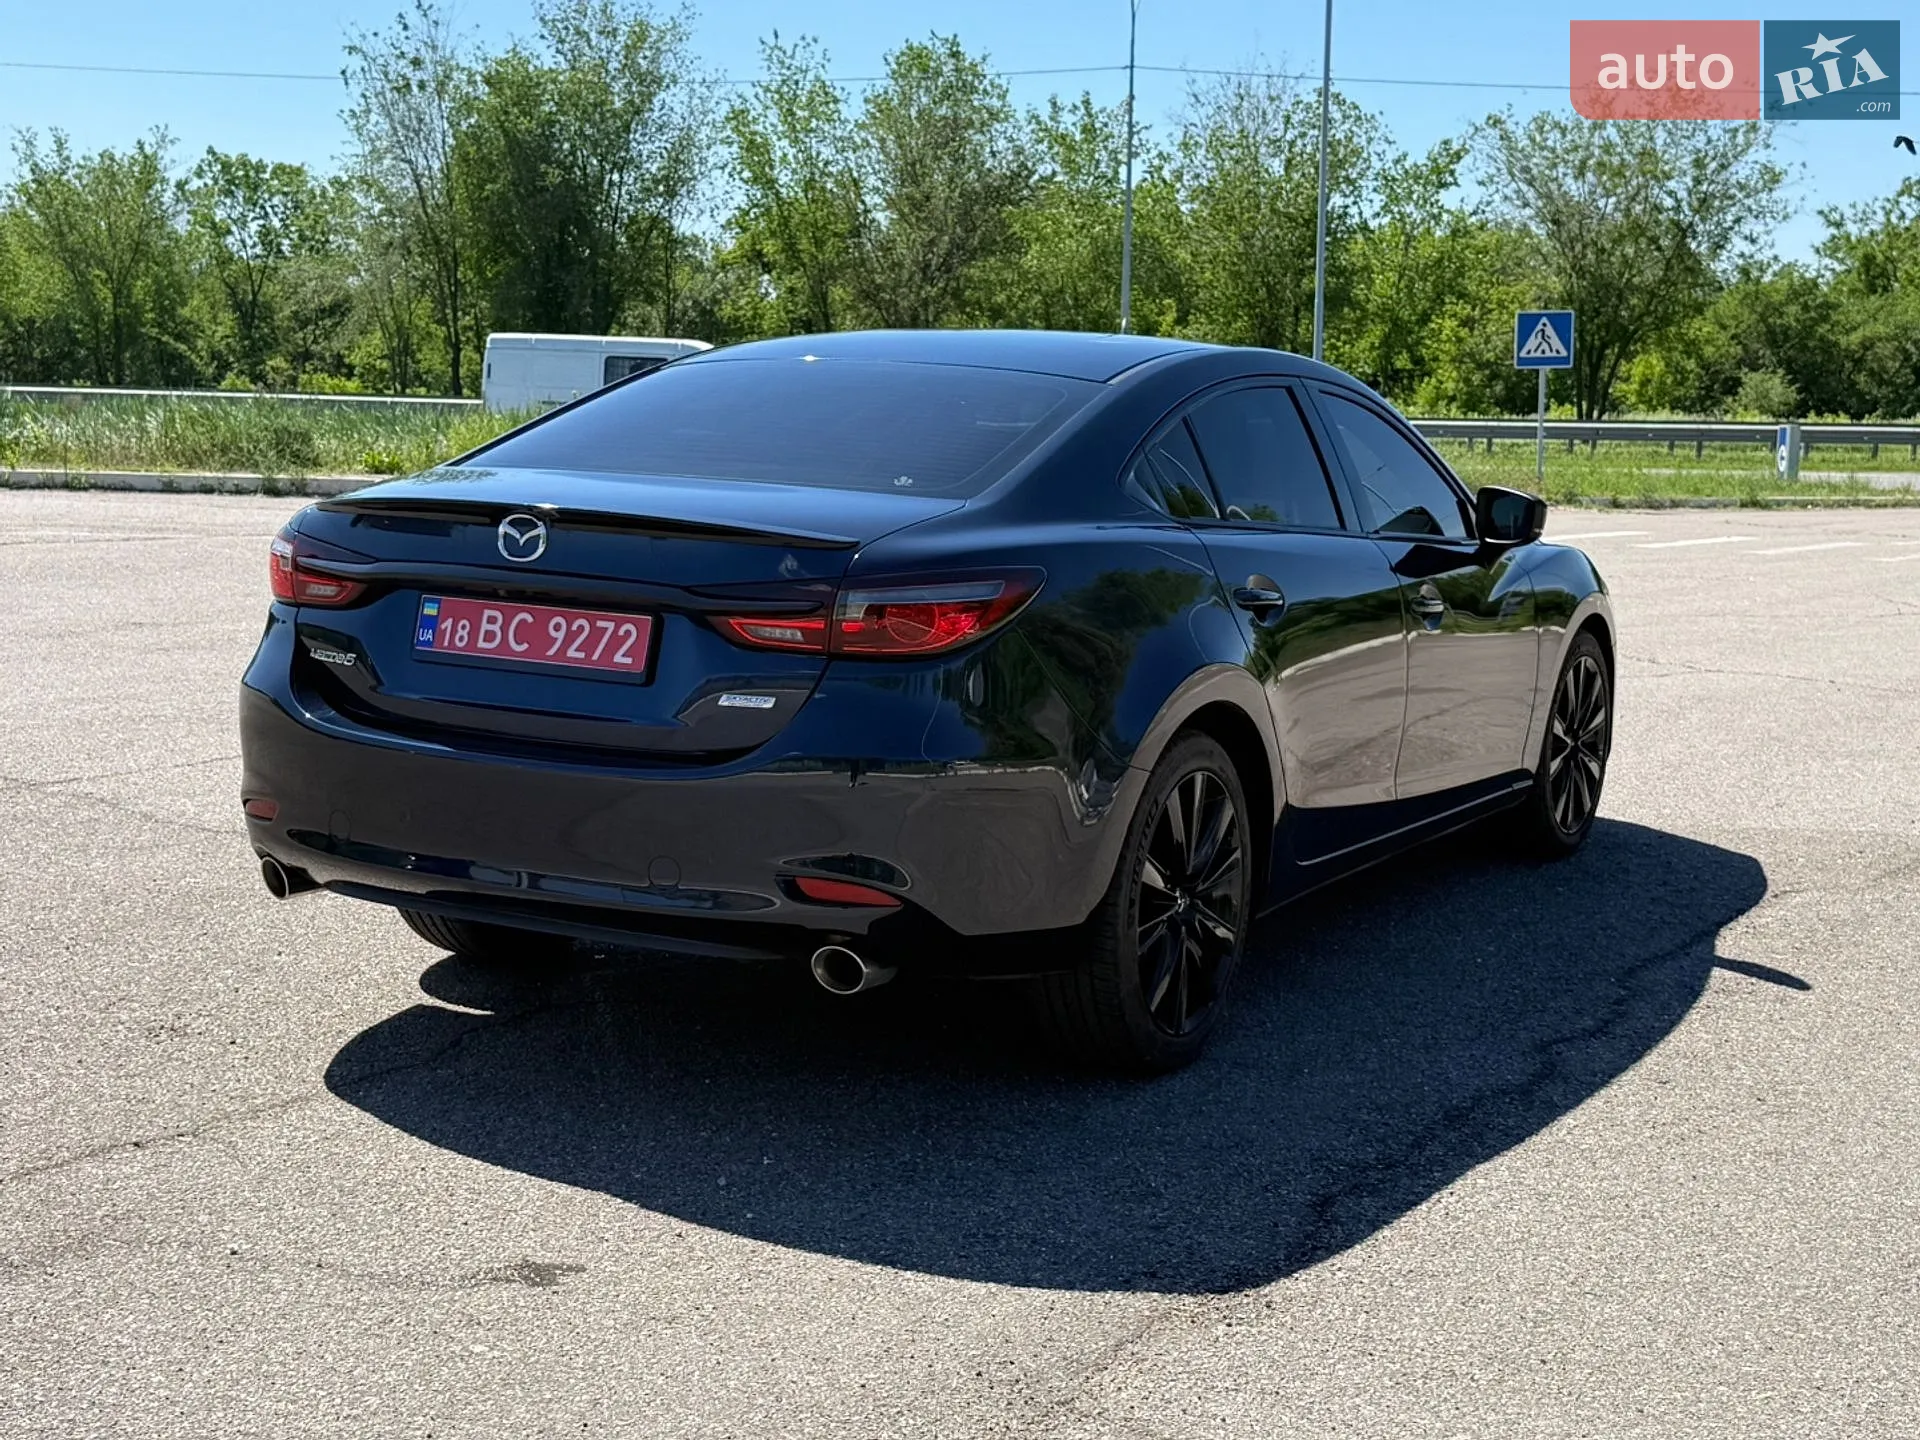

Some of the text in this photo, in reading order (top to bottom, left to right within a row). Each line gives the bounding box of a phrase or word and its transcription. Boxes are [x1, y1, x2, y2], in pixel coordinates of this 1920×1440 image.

[419, 628, 433, 642] UA
[440, 608, 638, 665] 18 BC 9272
